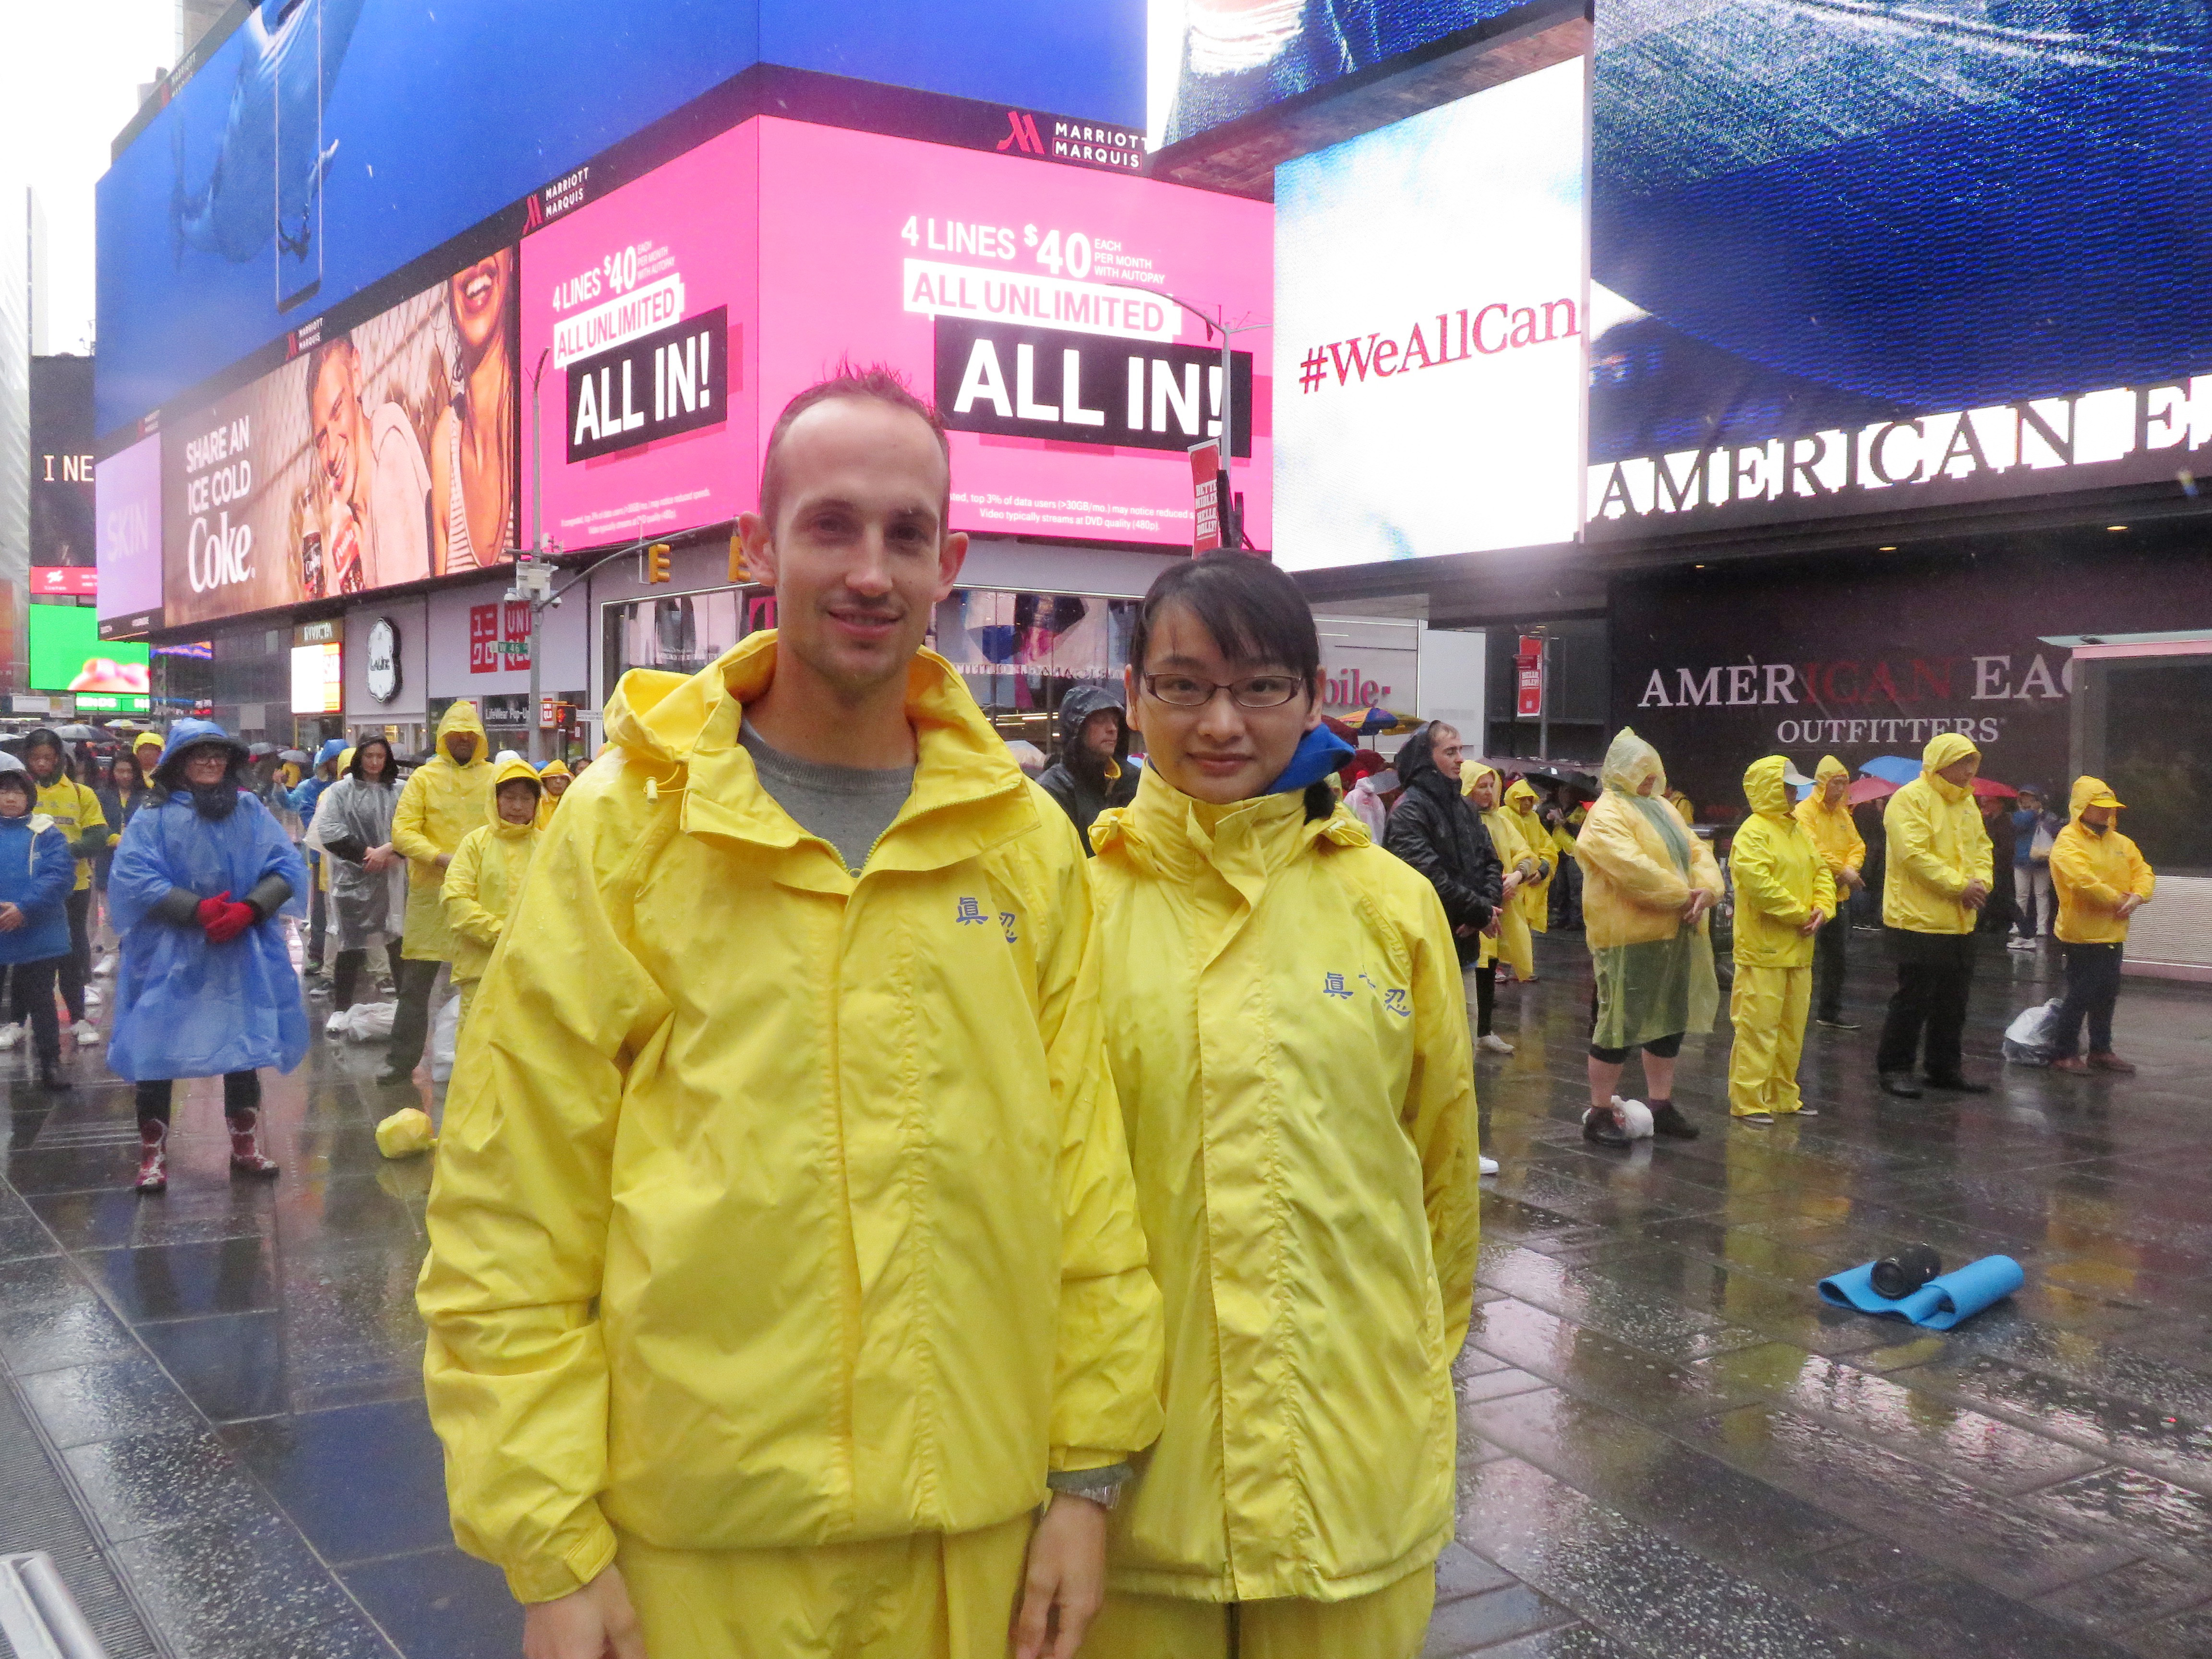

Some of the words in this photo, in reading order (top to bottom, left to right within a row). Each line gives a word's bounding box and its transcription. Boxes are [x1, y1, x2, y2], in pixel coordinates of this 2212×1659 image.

[1056, 121, 1147, 150] MARRIOTT
[1056, 140, 1139, 168] MARQUIS
[545, 166, 589, 202] MARRIOTT
[545, 188, 584, 218] MARQUIS
[901, 216, 919, 246] 4
[927, 218, 1015, 259] LINES
[1023, 224, 1092, 278] $40
[1094, 238, 1121, 252] EACH
[1094, 252, 1114, 264] PER
[1116, 254, 1152, 270] MONTH
[553, 285, 561, 312] 4
[563, 267, 601, 310] LINES
[603, 245, 637, 294] $40
[1094, 265, 1119, 280] WITH
[1120, 269, 1166, 285] AUTOPAY
[912, 271, 977, 311] ALL
[984, 280, 1165, 333] UNLIMITED
[557, 324, 585, 360] ALL
[587, 287, 675, 349] UNLIMITED
[1299, 297, 1582, 394] #WeAllCan
[574, 359, 644, 445] ALL
[655, 331, 710, 422] IN!
[953, 337, 1105, 427] ALL
[1127, 355, 1222, 437] IN!
[186, 425, 227, 474] SHARE
[229, 415, 250, 455] AN
[1592, 397, 2086, 521] AMERICAN
[2124, 377, 2191, 459] E
[43, 455, 55, 481] I
[63, 455, 95, 481] NE
[188, 475, 210, 516] ICE
[212, 459, 251, 506] COLD
[950, 492, 969, 503] sted,
[971, 494, 985, 504] top
[986, 493, 1002, 504] 3%
[1004, 495, 1013, 505] of
[1013, 496, 1033, 507] data
[1034, 500, 1057, 509] users
[1112, 505, 1129, 516] may
[1130, 506, 1154, 516] notice
[1156, 508, 1188, 519] reduced
[1196, 479, 1217, 497] BETTE
[979, 508, 1004, 519] Video
[1006, 510, 1040, 523] typically
[1042, 513, 1074, 524] streams
[1075, 516, 1083, 525] at
[1085, 516, 1103, 526] DVD
[1105, 518, 1131, 530] quality
[188, 511, 252, 593] Coke
[508, 608, 529, 633] UNI
[1637, 657, 1952, 708] AMERICAN
[1777, 717, 1999, 745] OUTFITTERS
